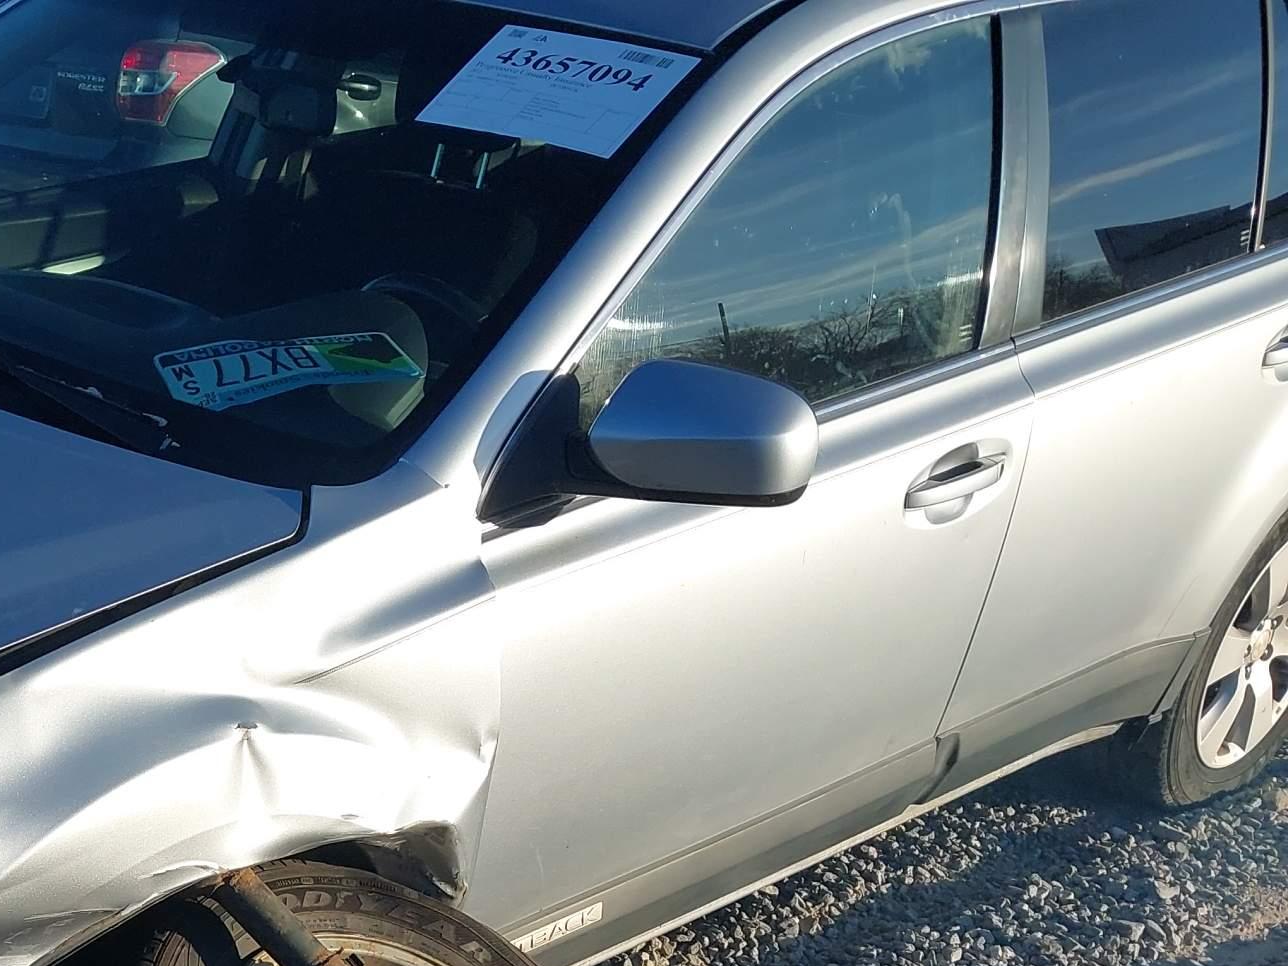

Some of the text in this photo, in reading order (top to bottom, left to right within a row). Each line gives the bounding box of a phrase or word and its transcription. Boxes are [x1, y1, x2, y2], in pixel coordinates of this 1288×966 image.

[496, 47, 654, 92] 43657094
[214, 345, 321, 387] BX77
[280, 888, 495, 963] ODYEAR
[513, 905, 600, 953] TBACK
